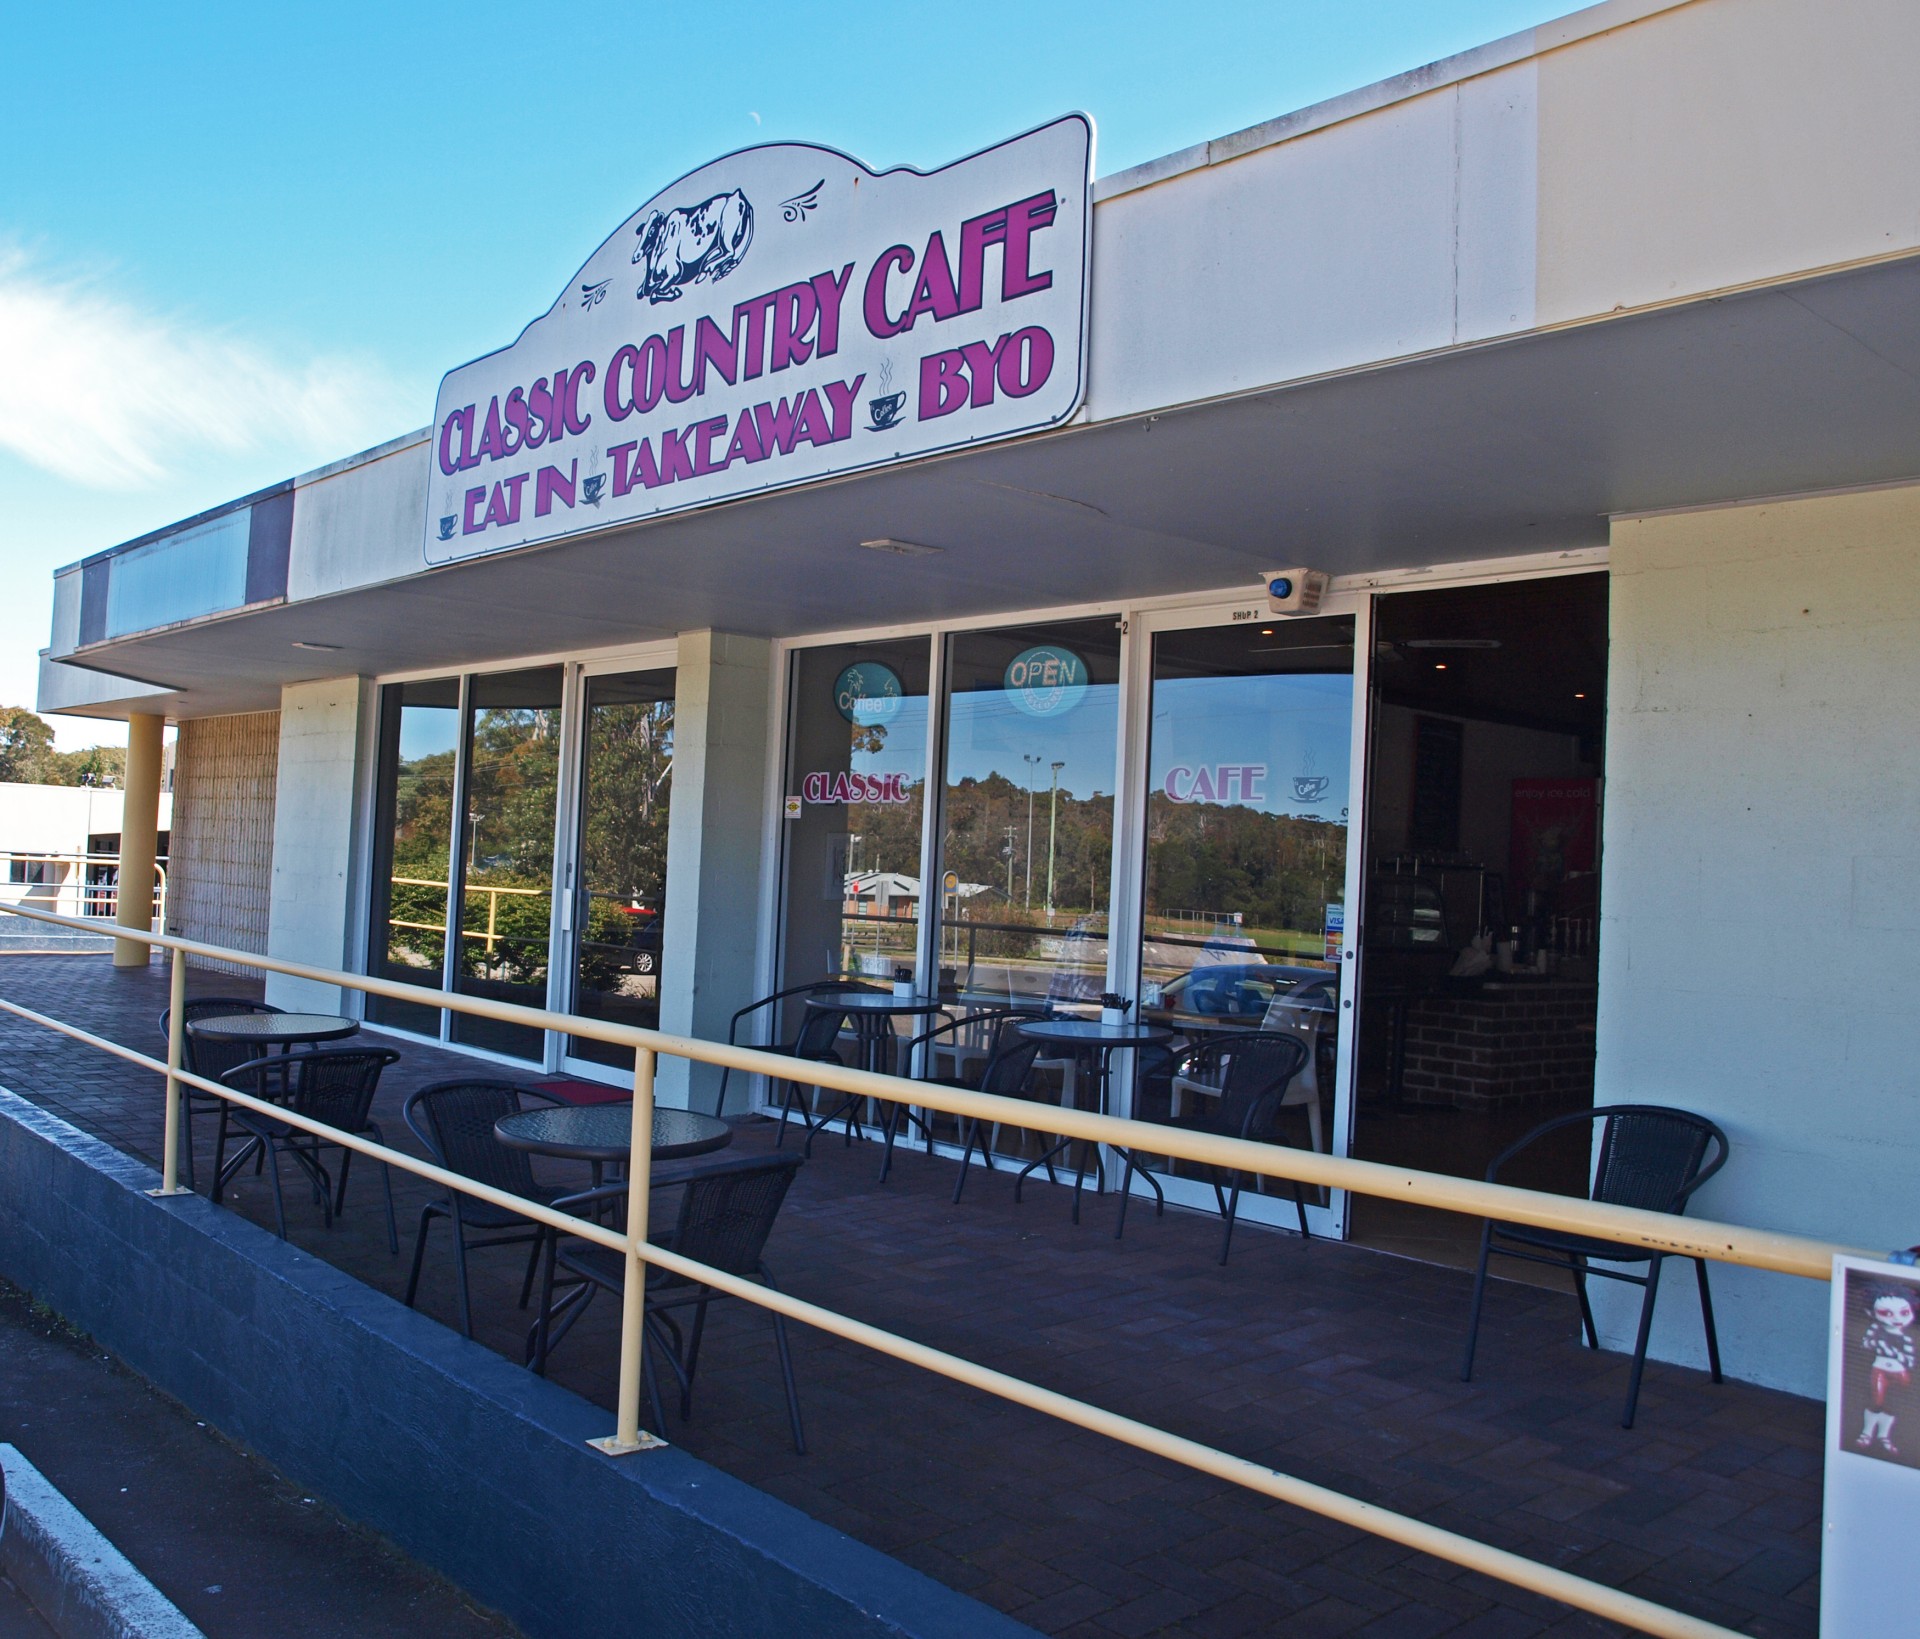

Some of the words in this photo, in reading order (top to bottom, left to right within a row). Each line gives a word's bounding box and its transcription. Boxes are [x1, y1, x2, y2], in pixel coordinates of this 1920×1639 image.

[439, 360, 596, 476] CLASSIC
[604, 261, 856, 422] COUNTRY
[863, 188, 1058, 339] CAFE
[874, 403, 893, 421] Coffee
[463, 472, 530, 536] EAT
[535, 458, 578, 517] IN
[607, 373, 867, 498] TAKEAWAY
[918, 325, 1055, 422] BYO
[1253, 610, 1259, 619] 2
[1122, 621, 1129, 635] 2
[1011, 659, 1077, 687] OPEN
[839, 691, 883, 713] Coffee
[803, 771, 911, 803] CLASSIC
[1165, 765, 1267, 802] CAFE
[1298, 782, 1315, 795] Coffee
[1514, 788, 1545, 800] enjoy
[1547, 788, 1563, 798] ice
[1566, 787, 1591, 798] cold
